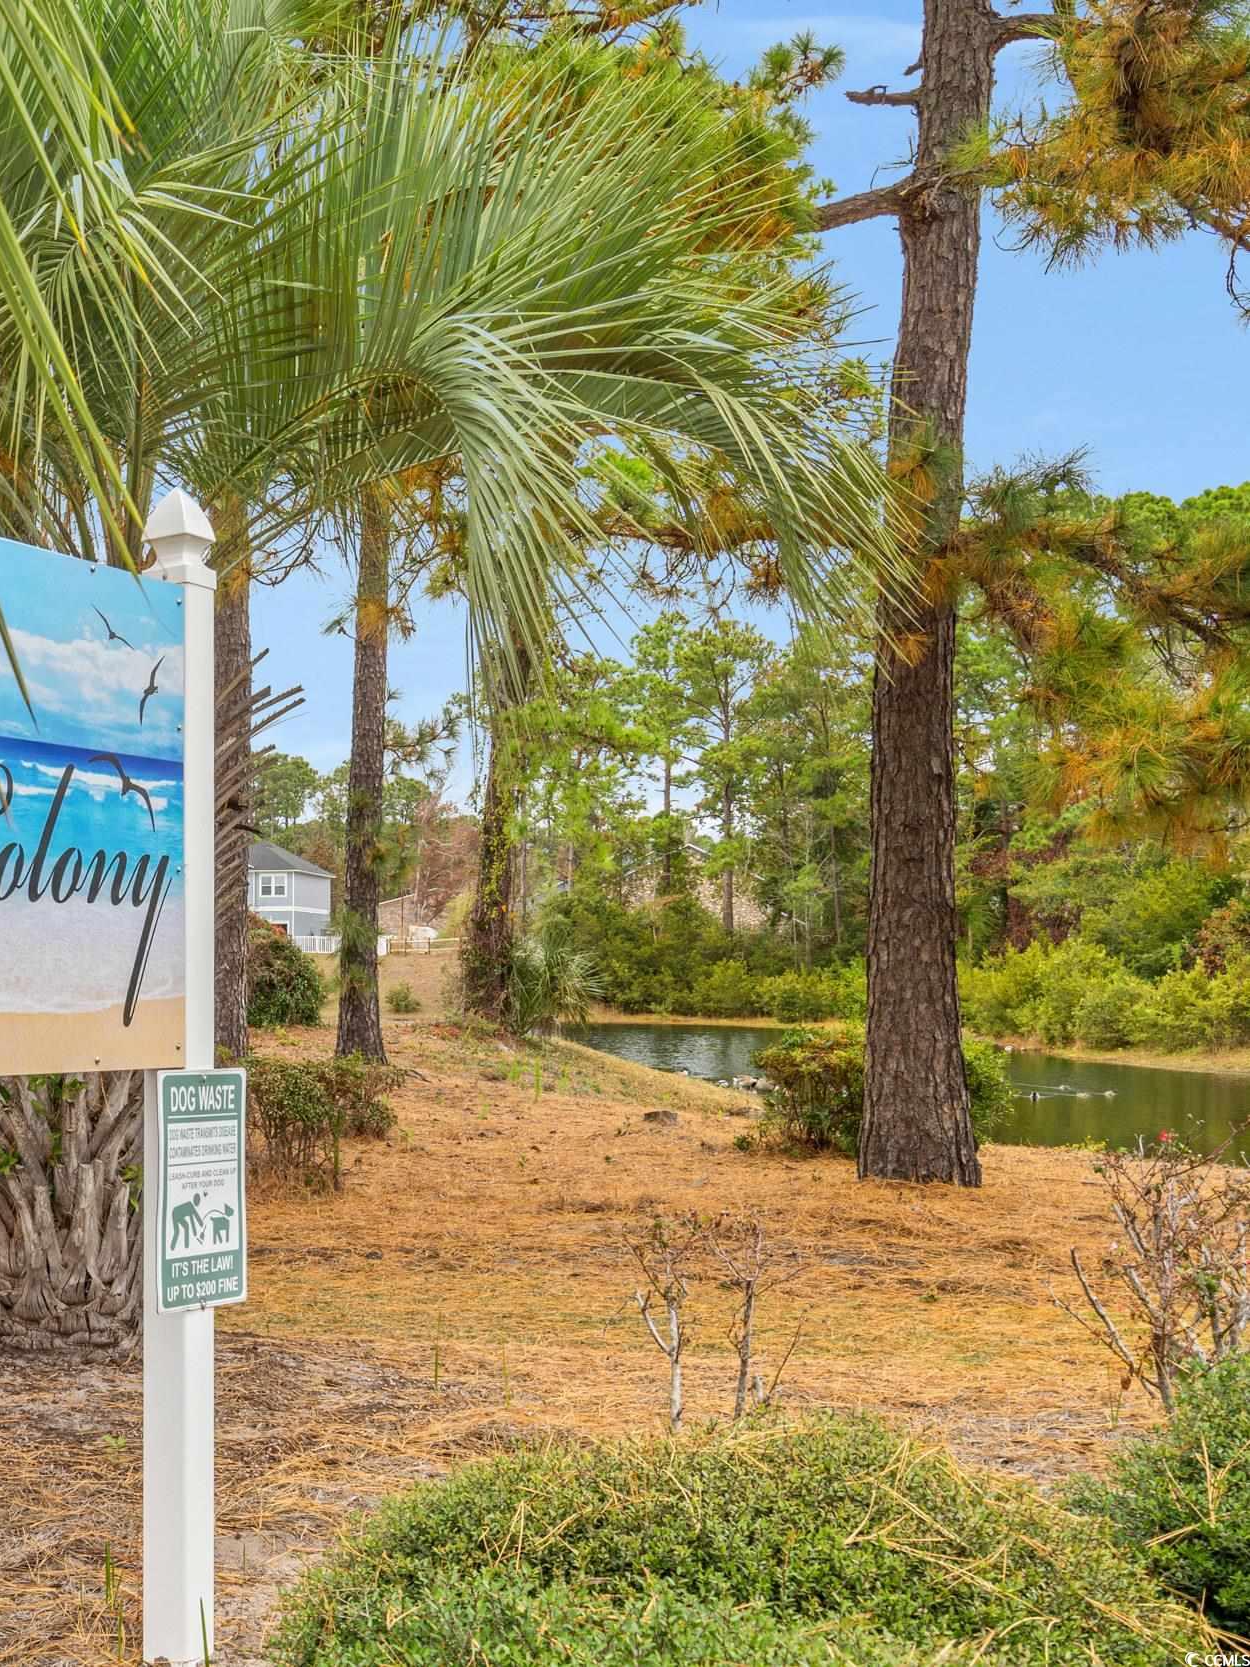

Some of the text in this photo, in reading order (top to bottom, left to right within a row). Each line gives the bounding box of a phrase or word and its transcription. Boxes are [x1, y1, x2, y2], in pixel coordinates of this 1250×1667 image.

[170, 1084, 236, 1113] DOG WASTE
[172, 1255, 234, 1279] IT'S THE LAW!
[167, 1276, 239, 1303] UP TO $200 FINE
